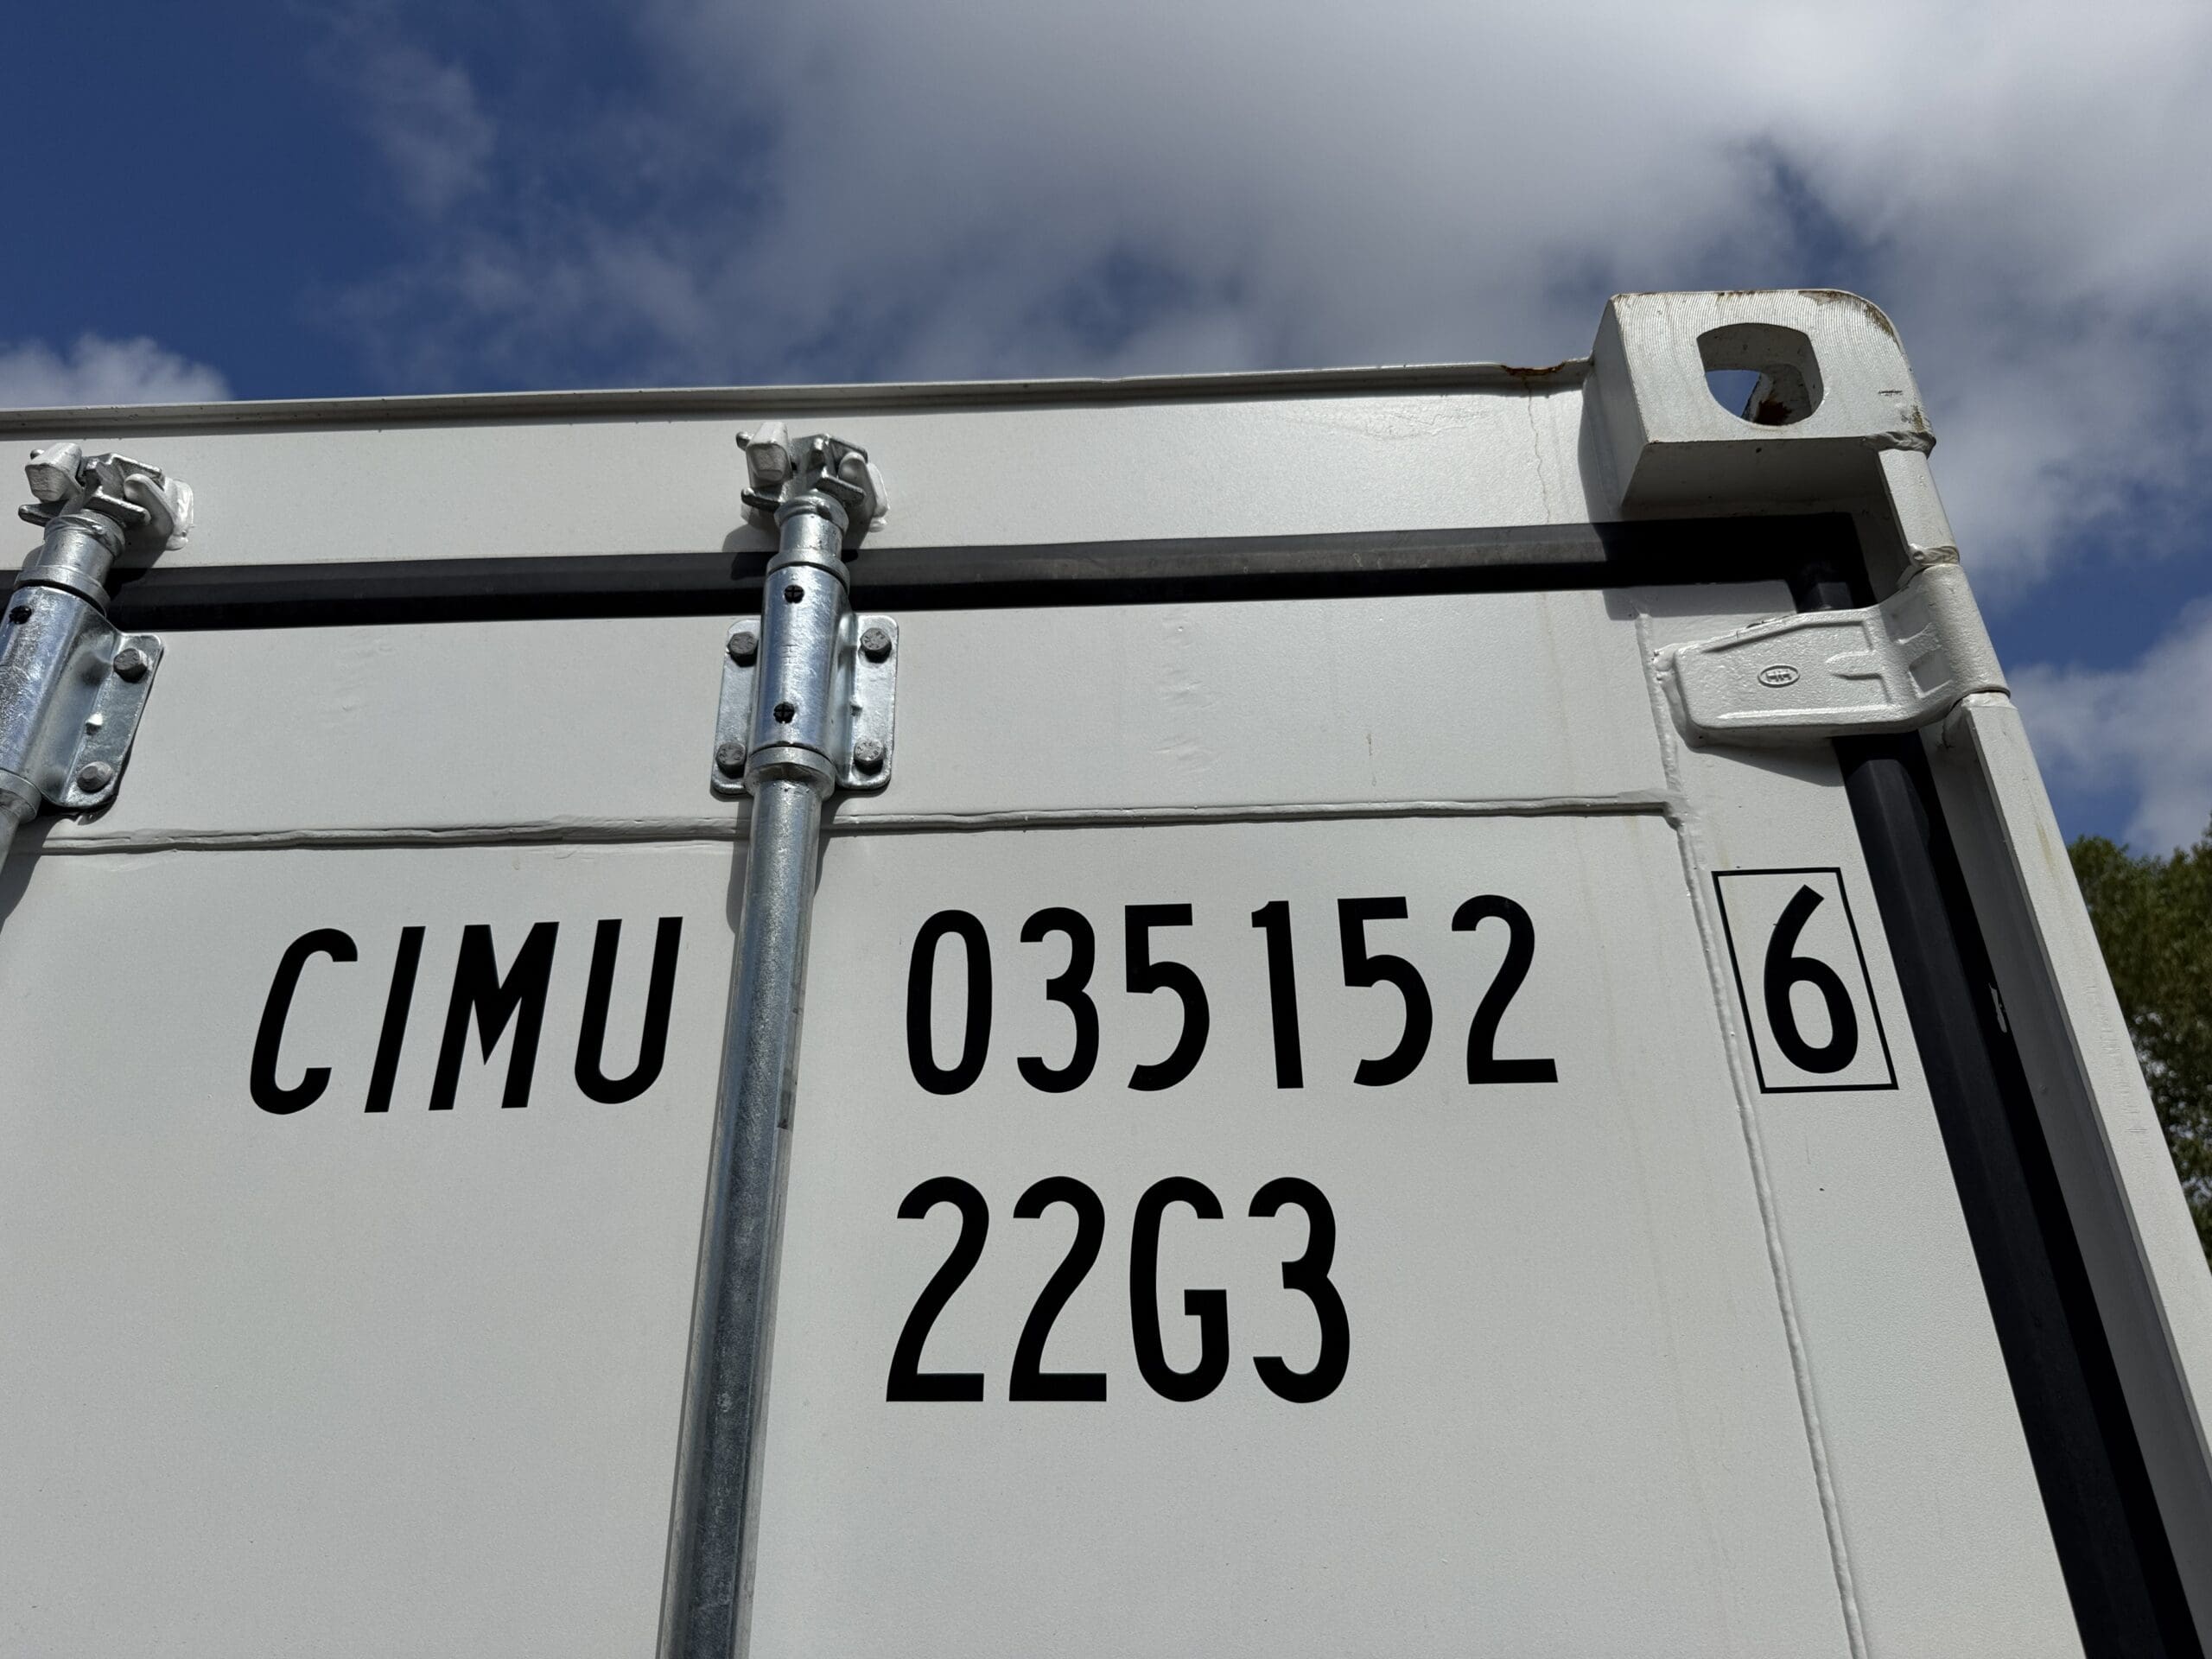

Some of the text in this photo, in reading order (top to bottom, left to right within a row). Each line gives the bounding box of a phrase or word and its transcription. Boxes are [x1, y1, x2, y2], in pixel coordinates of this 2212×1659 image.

[250, 884, 1859, 1116] CIMU 035152 6
[886, 1176, 1351, 1404] 22G3
